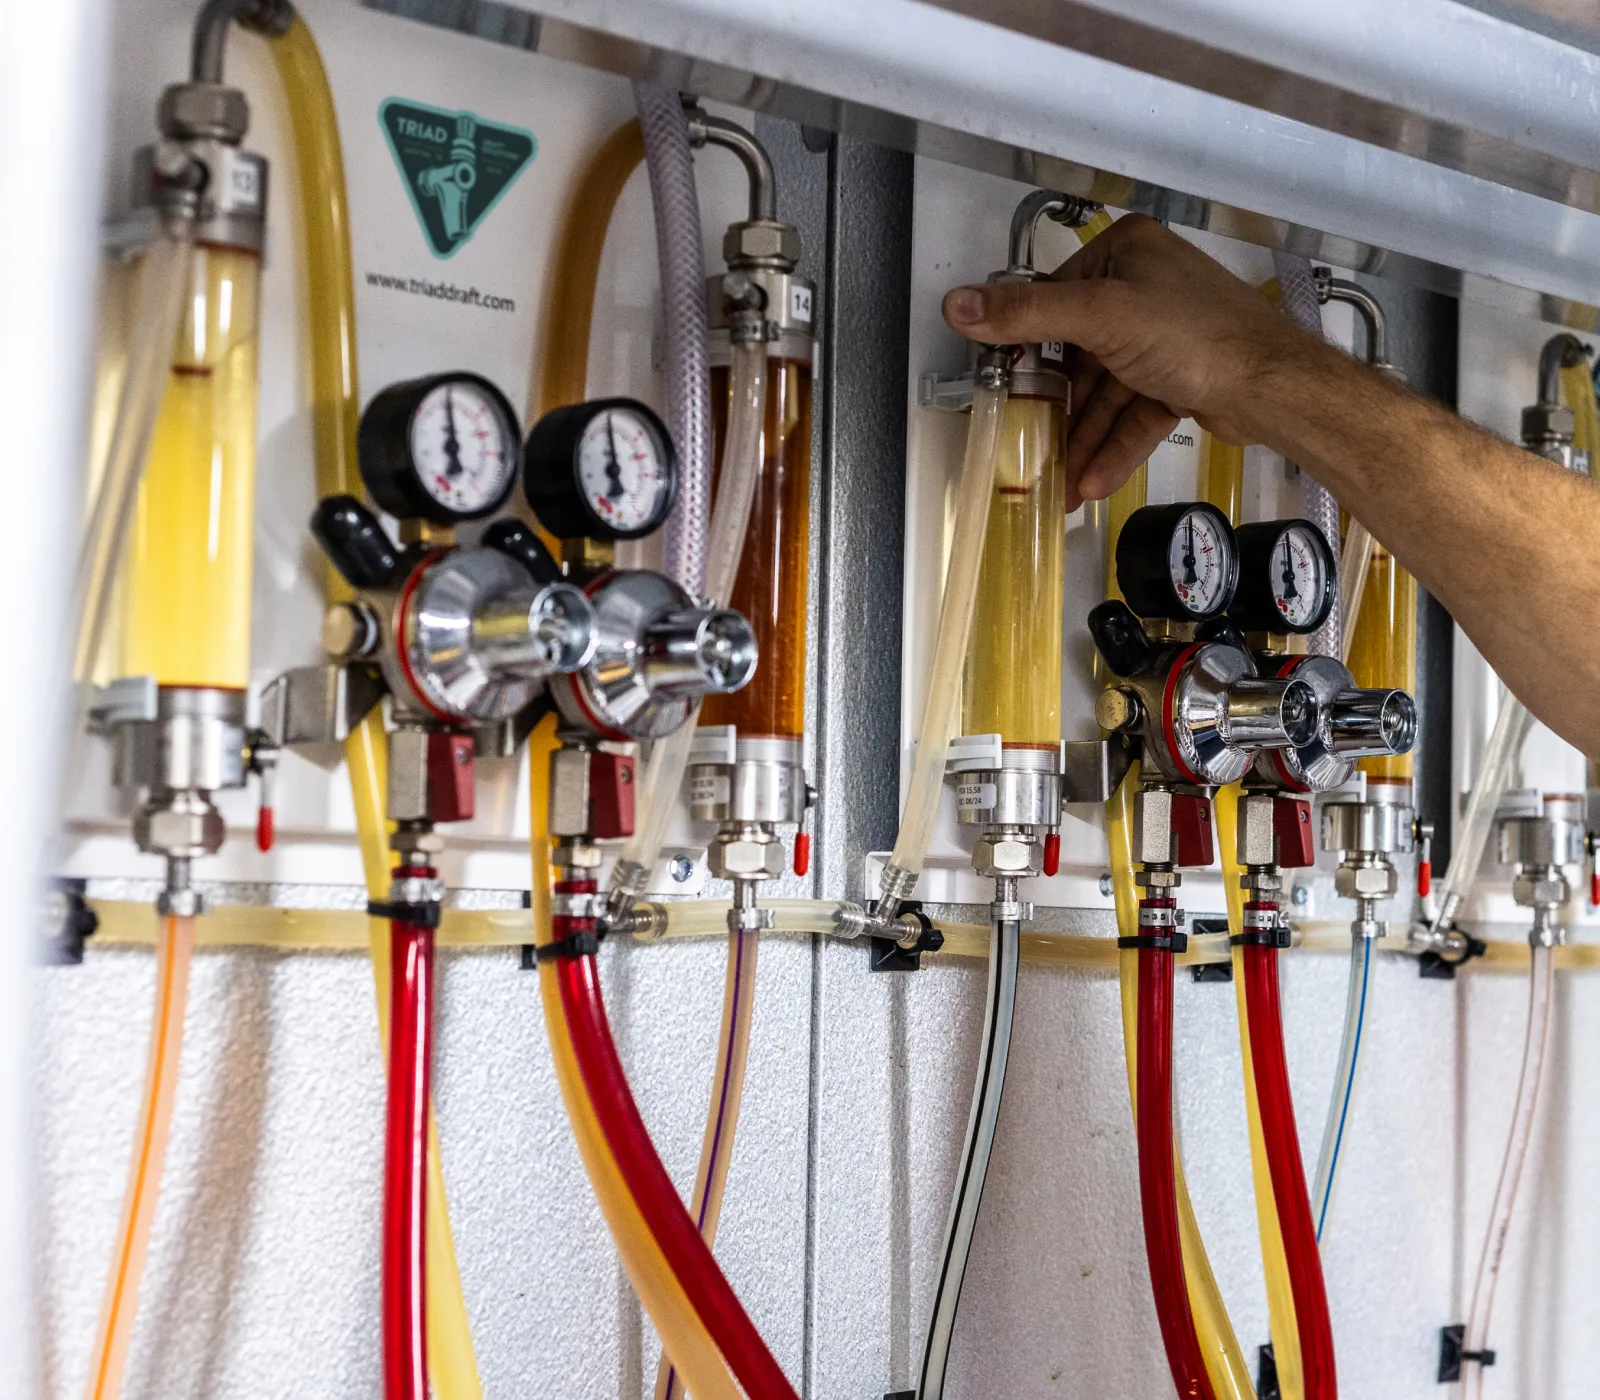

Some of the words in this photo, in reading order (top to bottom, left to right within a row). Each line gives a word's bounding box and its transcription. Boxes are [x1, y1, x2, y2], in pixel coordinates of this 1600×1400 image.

[396, 116, 448, 143] TRIAD
[795, 292, 809, 312] 14
[1048, 341, 1062, 353] 15
